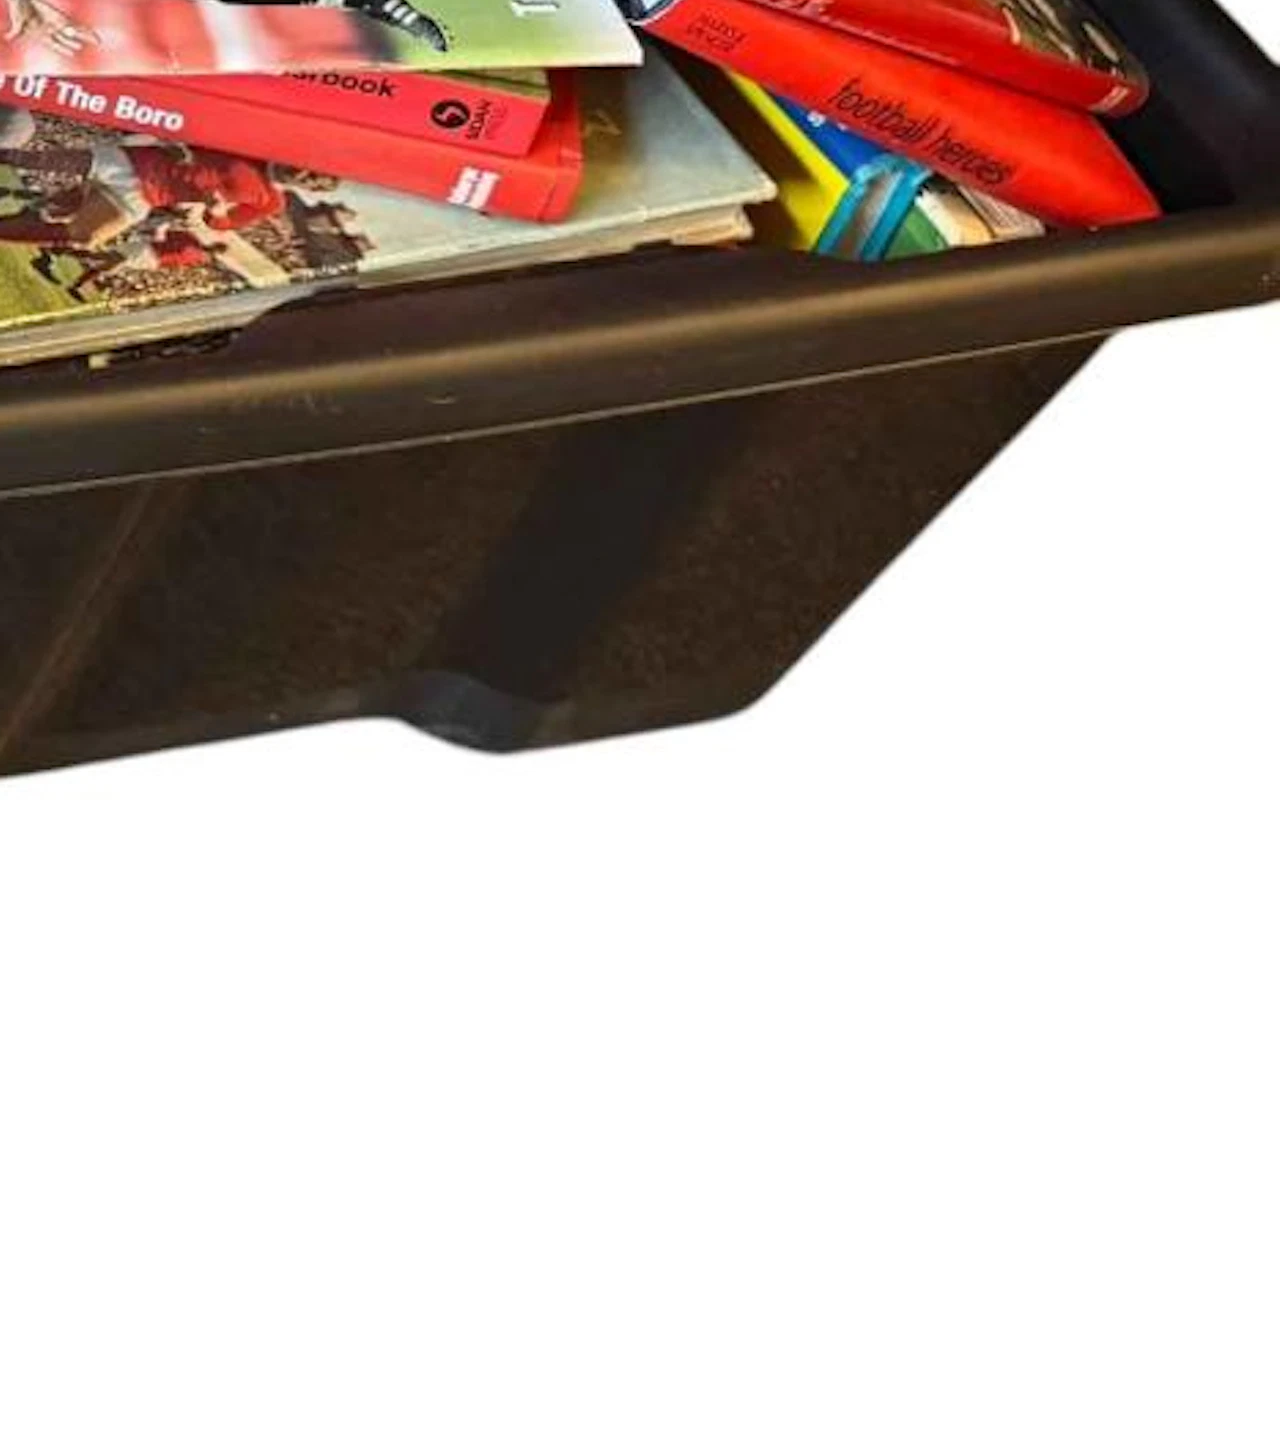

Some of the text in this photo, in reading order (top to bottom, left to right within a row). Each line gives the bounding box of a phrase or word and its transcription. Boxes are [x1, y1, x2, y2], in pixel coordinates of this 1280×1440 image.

[13, 72, 50, 98] Of
[56, 80, 107, 114] The
[114, 95, 185, 134] Boro
[828, 80, 1010, 185] football heroes
